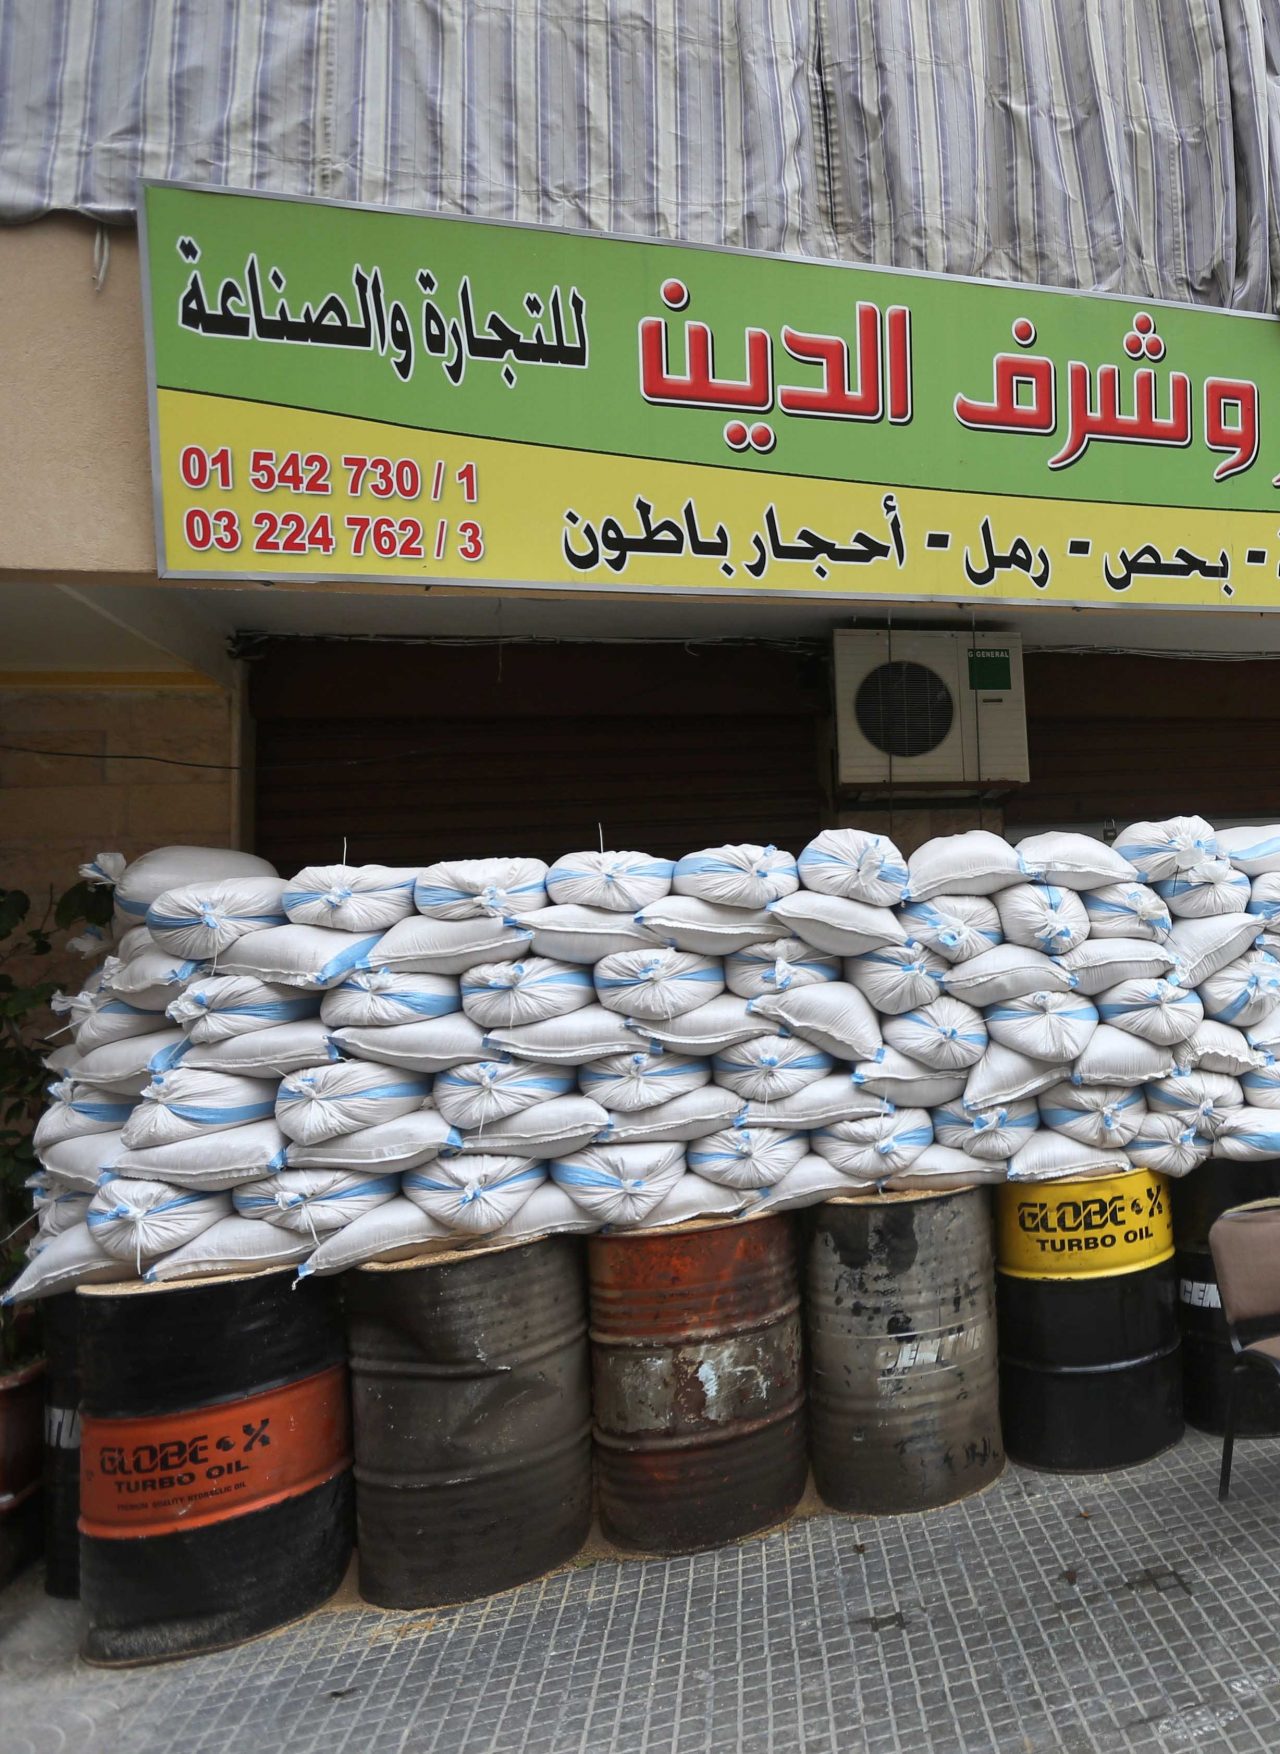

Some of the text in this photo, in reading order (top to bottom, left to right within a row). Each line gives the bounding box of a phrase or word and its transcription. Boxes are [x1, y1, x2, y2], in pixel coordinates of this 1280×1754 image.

[179, 236, 412, 382] والصناعة
[422, 269, 588, 388] للتجارة
[639, 277, 914, 455] الدين
[182, 446, 232, 490] 01
[251, 450, 331, 496] 542
[345, 456, 420, 500] 730
[456, 463, 478, 502] 1
[185, 508, 240, 551] 03
[254, 511, 333, 554] 224
[345, 516, 424, 557] 762
[458, 521, 484, 560] 3
[562, 496, 734, 577] باطون
[744, 493, 905, 579] أحجار
[964, 516, 1051, 588] رمل
[1104, 542, 1232, 597] بحص
[1017, 1195, 1126, 1234] GLOBE
[1036, 1227, 1154, 1252] TURBO OIL
[99, 1435, 208, 1475] GLOBE
[114, 1459, 250, 1494] TURBO OIL
[152, 1497, 184, 1509] QUALITY
[234, 1481, 247, 1491] OIL
